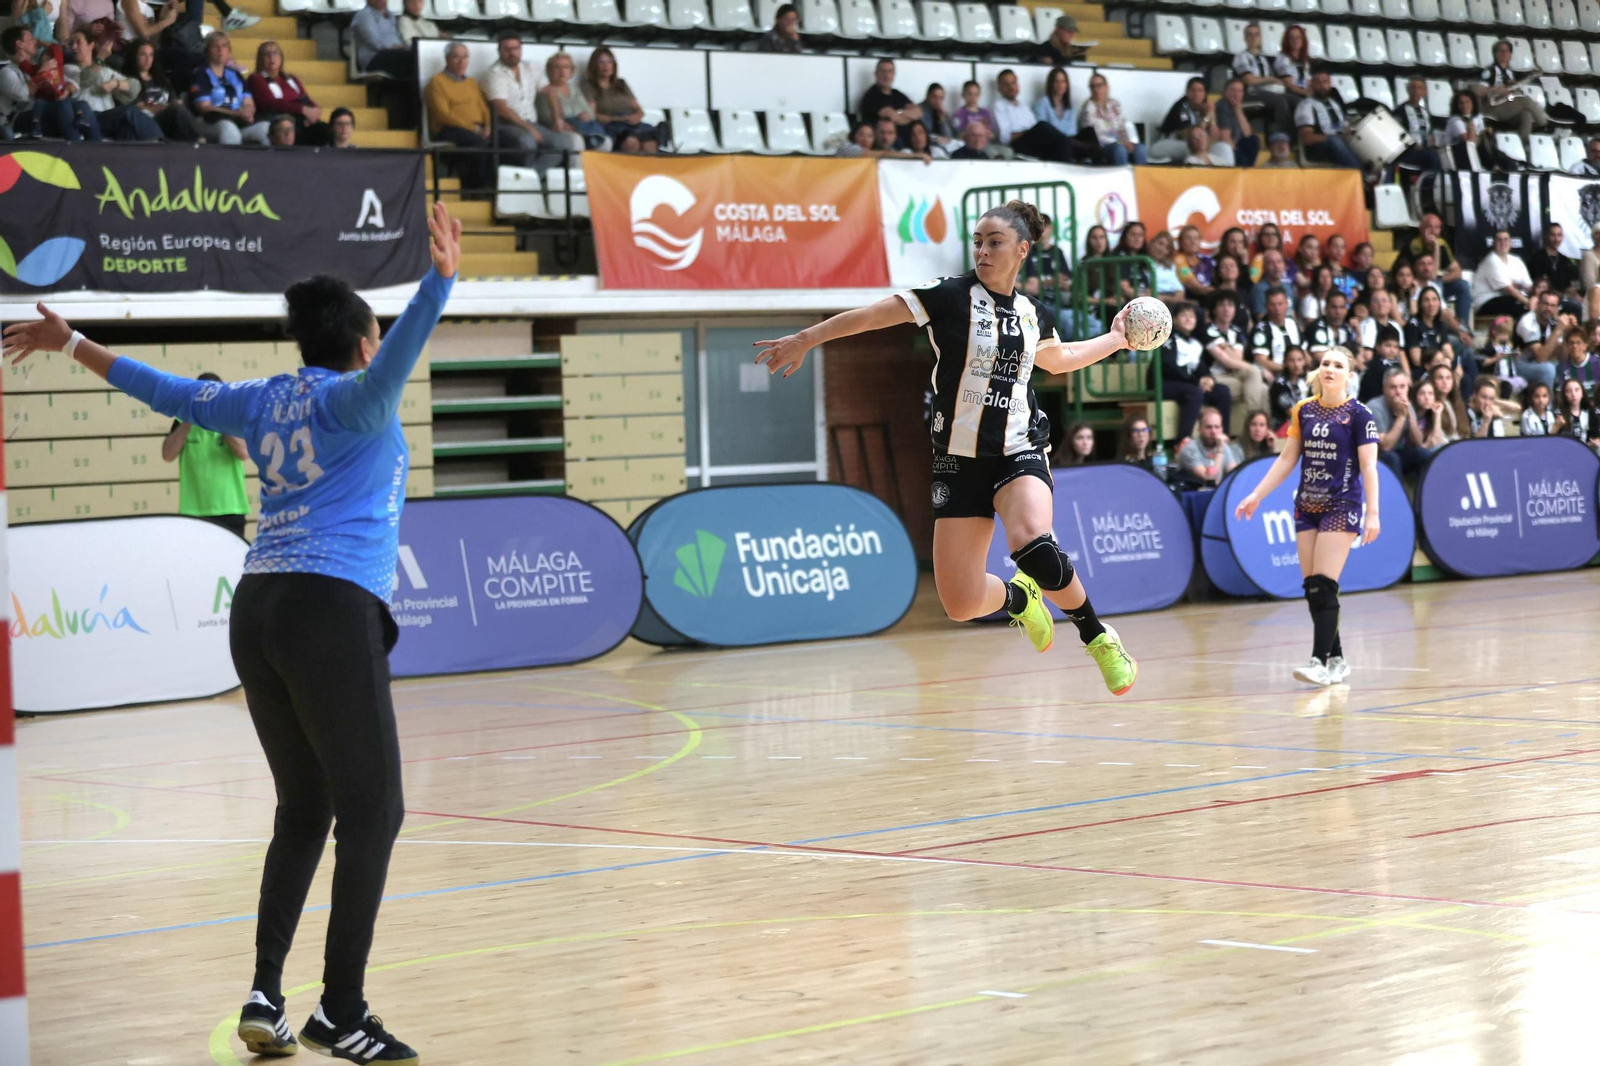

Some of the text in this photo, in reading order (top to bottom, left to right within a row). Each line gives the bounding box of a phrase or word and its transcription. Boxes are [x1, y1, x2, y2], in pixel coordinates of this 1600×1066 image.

[95, 163, 282, 220] Andalucía
[713, 202, 841, 222] COSTA DEL SOL
[1236, 209, 1335, 226] COSTA DEL SOL
[716, 223, 788, 243] MÁLAGA
[99, 233, 263, 255] Región Europea del
[103, 256, 188, 274] DEPORTE
[1001, 316, 1021, 337] 13
[962, 388, 1027, 414] málaga
[1312, 422, 1330, 438] 66
[1304, 440, 1337, 450] Motive
[1305, 450, 1338, 460] market
[260, 426, 325, 497] 23
[1528, 479, 1581, 498] MÁLAGA
[1526, 496, 1586, 518] COMPITE
[1092, 511, 1154, 533] MÁLAGA
[735, 523, 883, 563] Fundación
[1092, 530, 1164, 554] COMPITE
[486, 550, 583, 576] MÁLAGA
[484, 570, 595, 599] COMPITE
[742, 561, 850, 601] Unicaja
[9, 583, 151, 640] dalucía
[404, 595, 458, 610] Provincial
[495, 601, 506, 610] LA
[507, 599, 548, 610] PROVINCIA
[549, 598, 560, 607] EN
[198, 619, 217, 628] Junta
